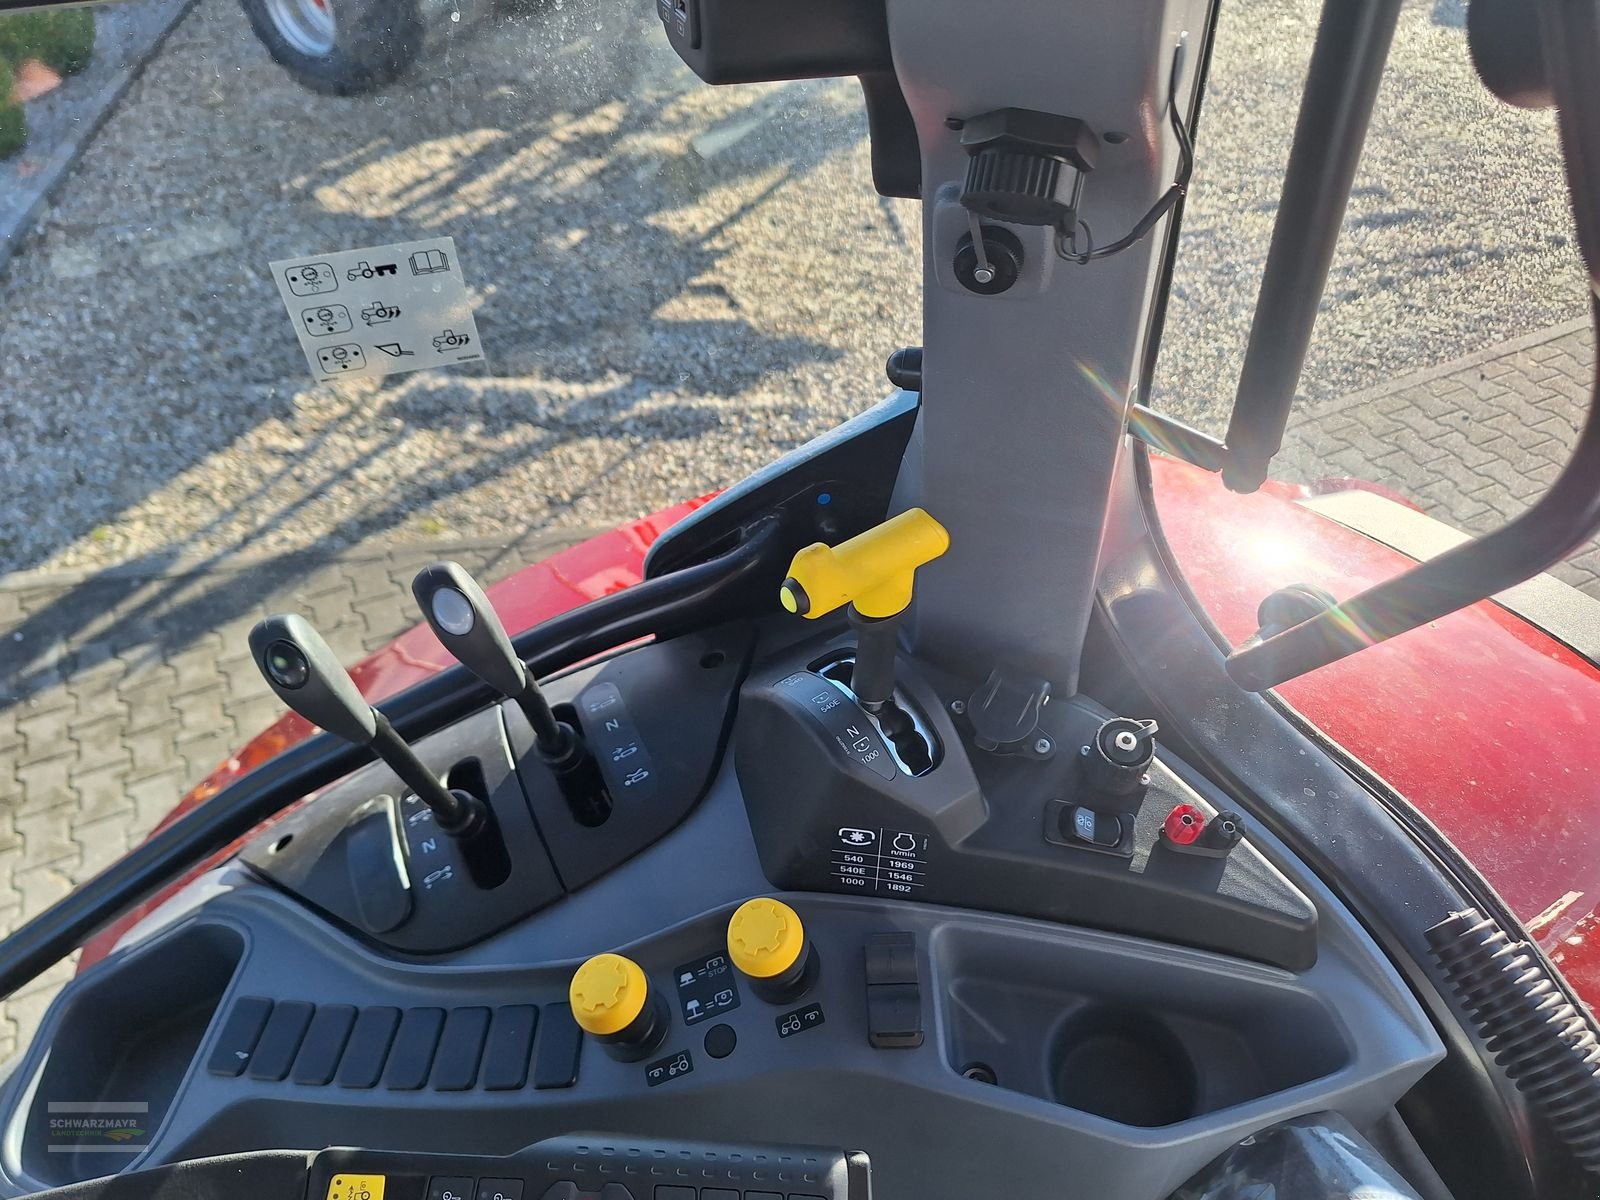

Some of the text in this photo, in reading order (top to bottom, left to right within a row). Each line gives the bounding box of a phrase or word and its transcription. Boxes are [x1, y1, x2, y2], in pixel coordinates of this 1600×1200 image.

[820, 698, 841, 713] 540E
[605, 718, 619, 731] N
[846, 725, 860, 738] N
[861, 749, 880, 765] 1000
[421, 837, 436, 854] N
[844, 854, 864, 863] 540
[890, 849, 916, 858] n/min
[840, 865, 866, 875] 540E
[889, 860, 914, 870] 1969
[840, 877, 865, 886] 1000
[887, 872, 913, 881] 1546
[887, 883, 911, 892] 1892
[708, 965, 728, 978] STOP
